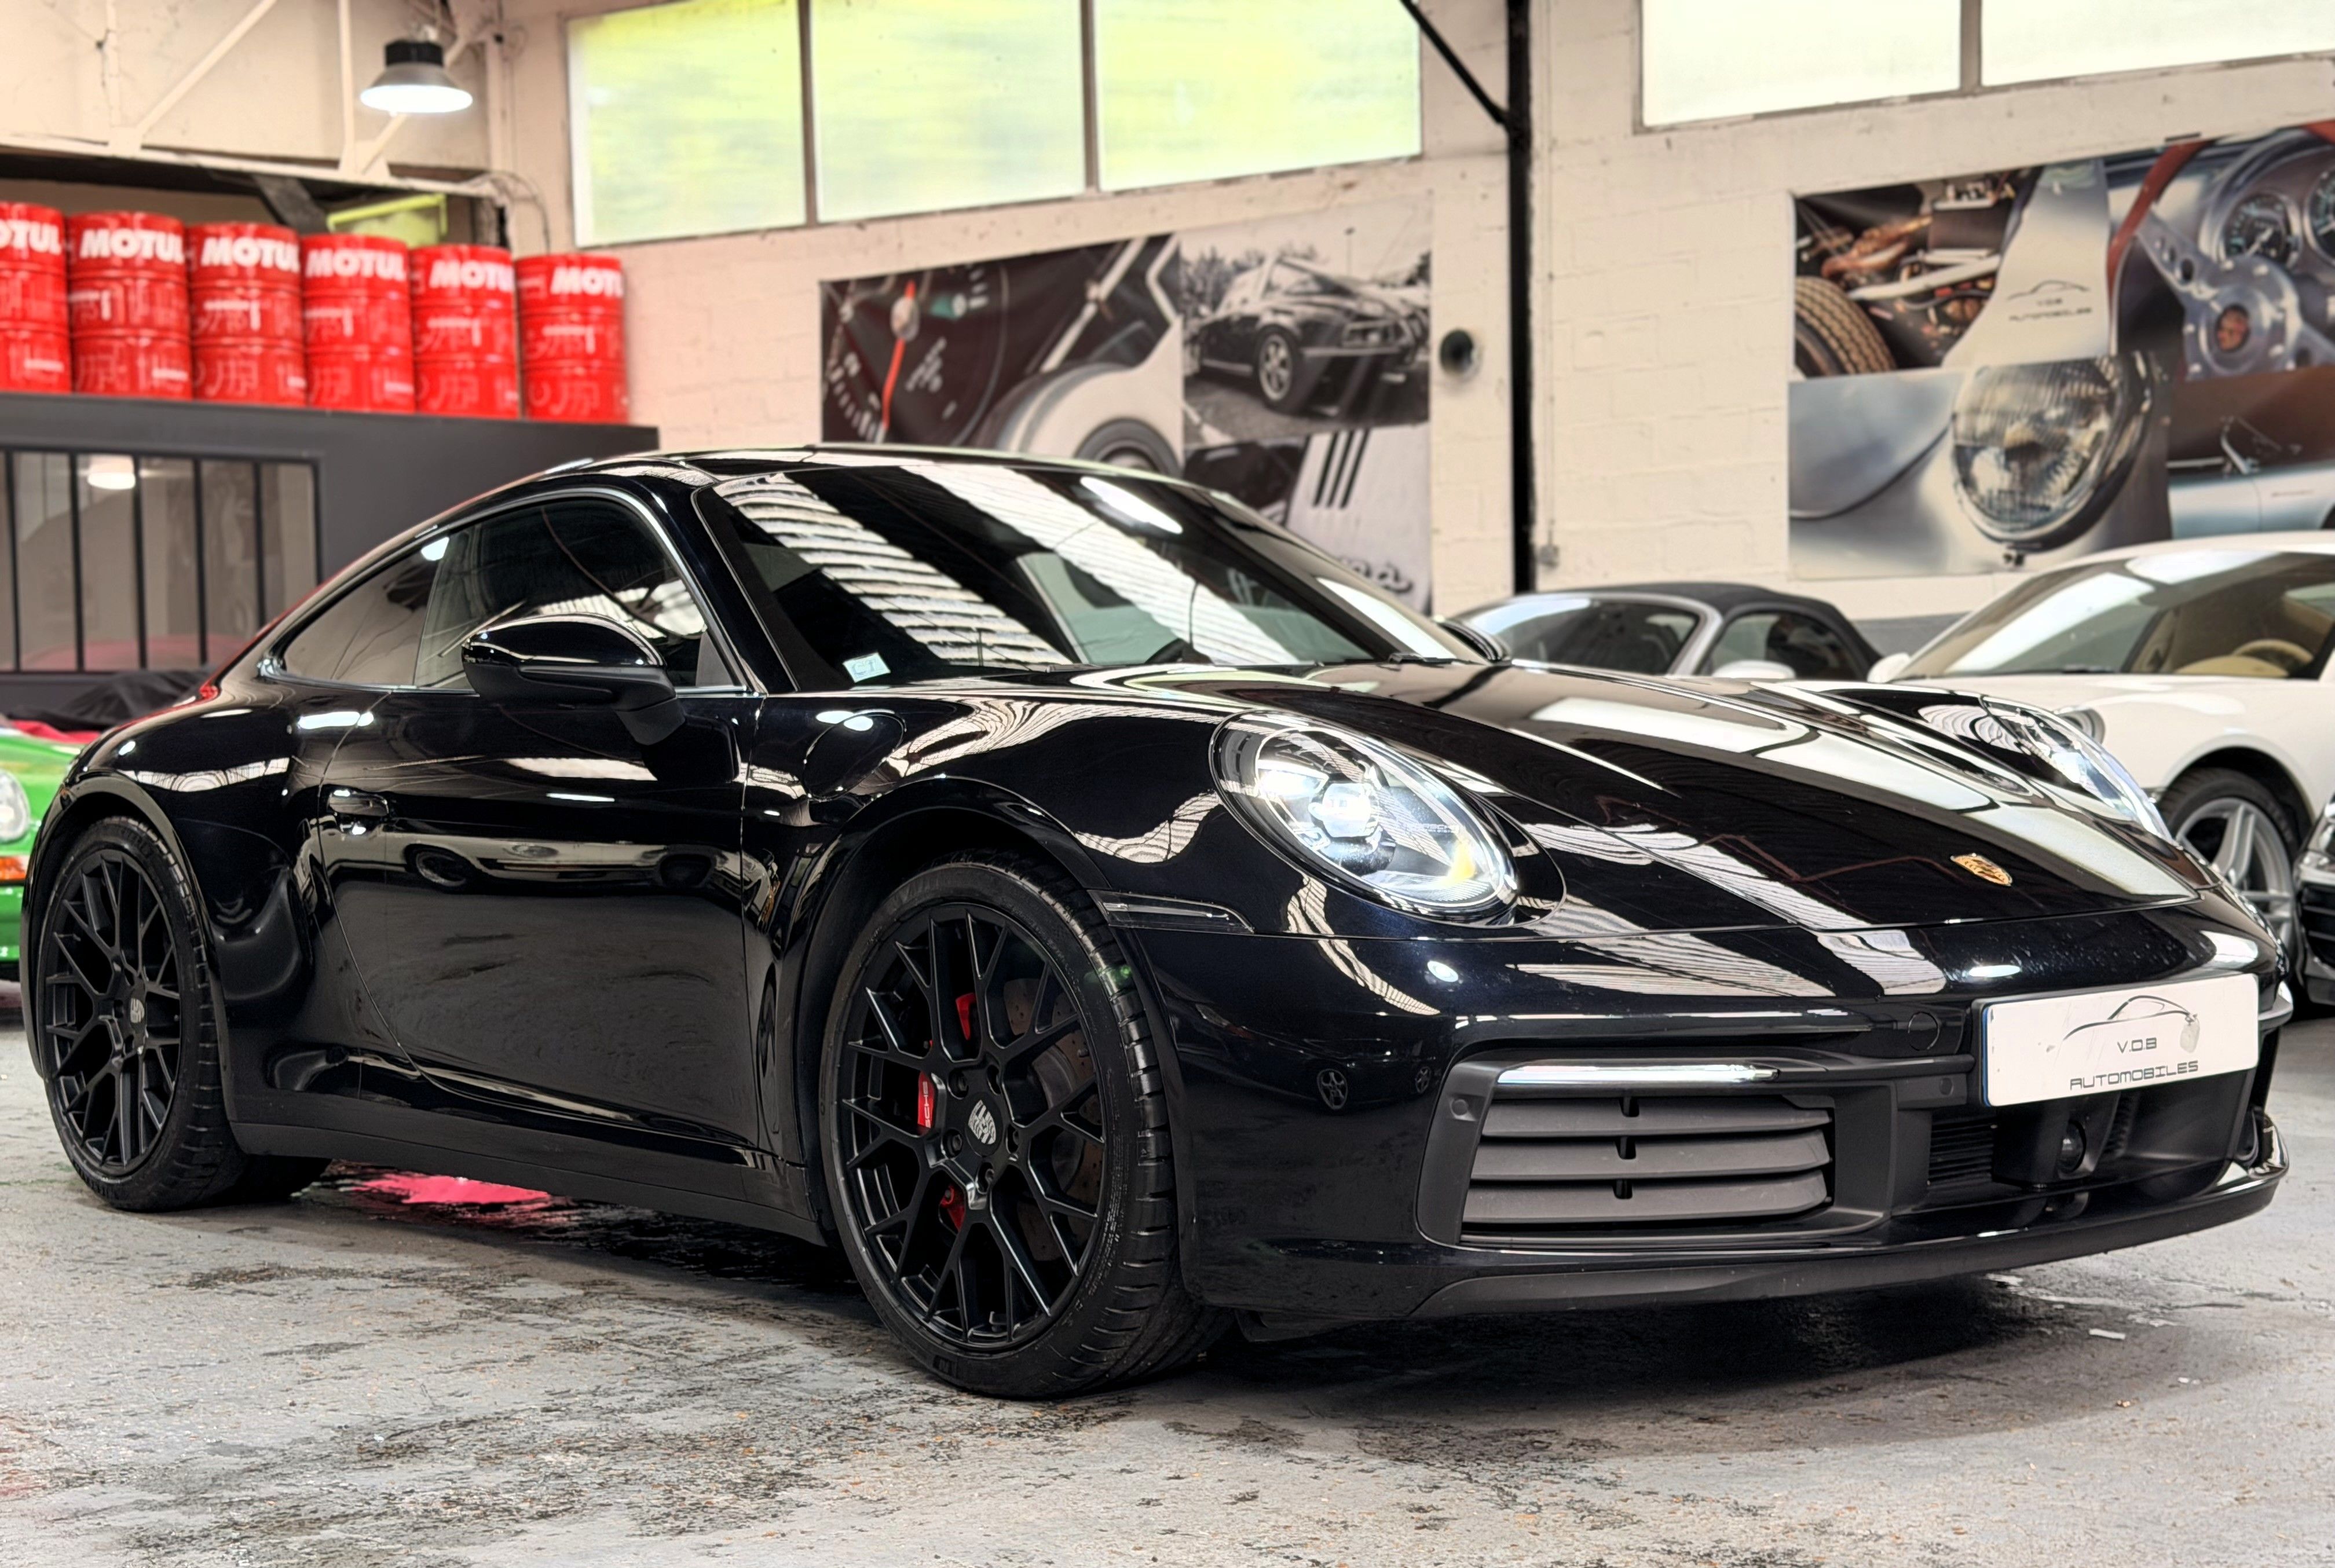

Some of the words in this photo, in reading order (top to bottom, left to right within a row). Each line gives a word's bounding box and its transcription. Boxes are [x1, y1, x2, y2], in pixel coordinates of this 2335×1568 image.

[79, 228, 185, 264] MOTUL
[306, 248, 407, 282] MOTUL
[2070, 1060, 2198, 1090] AUTOMOBILES
